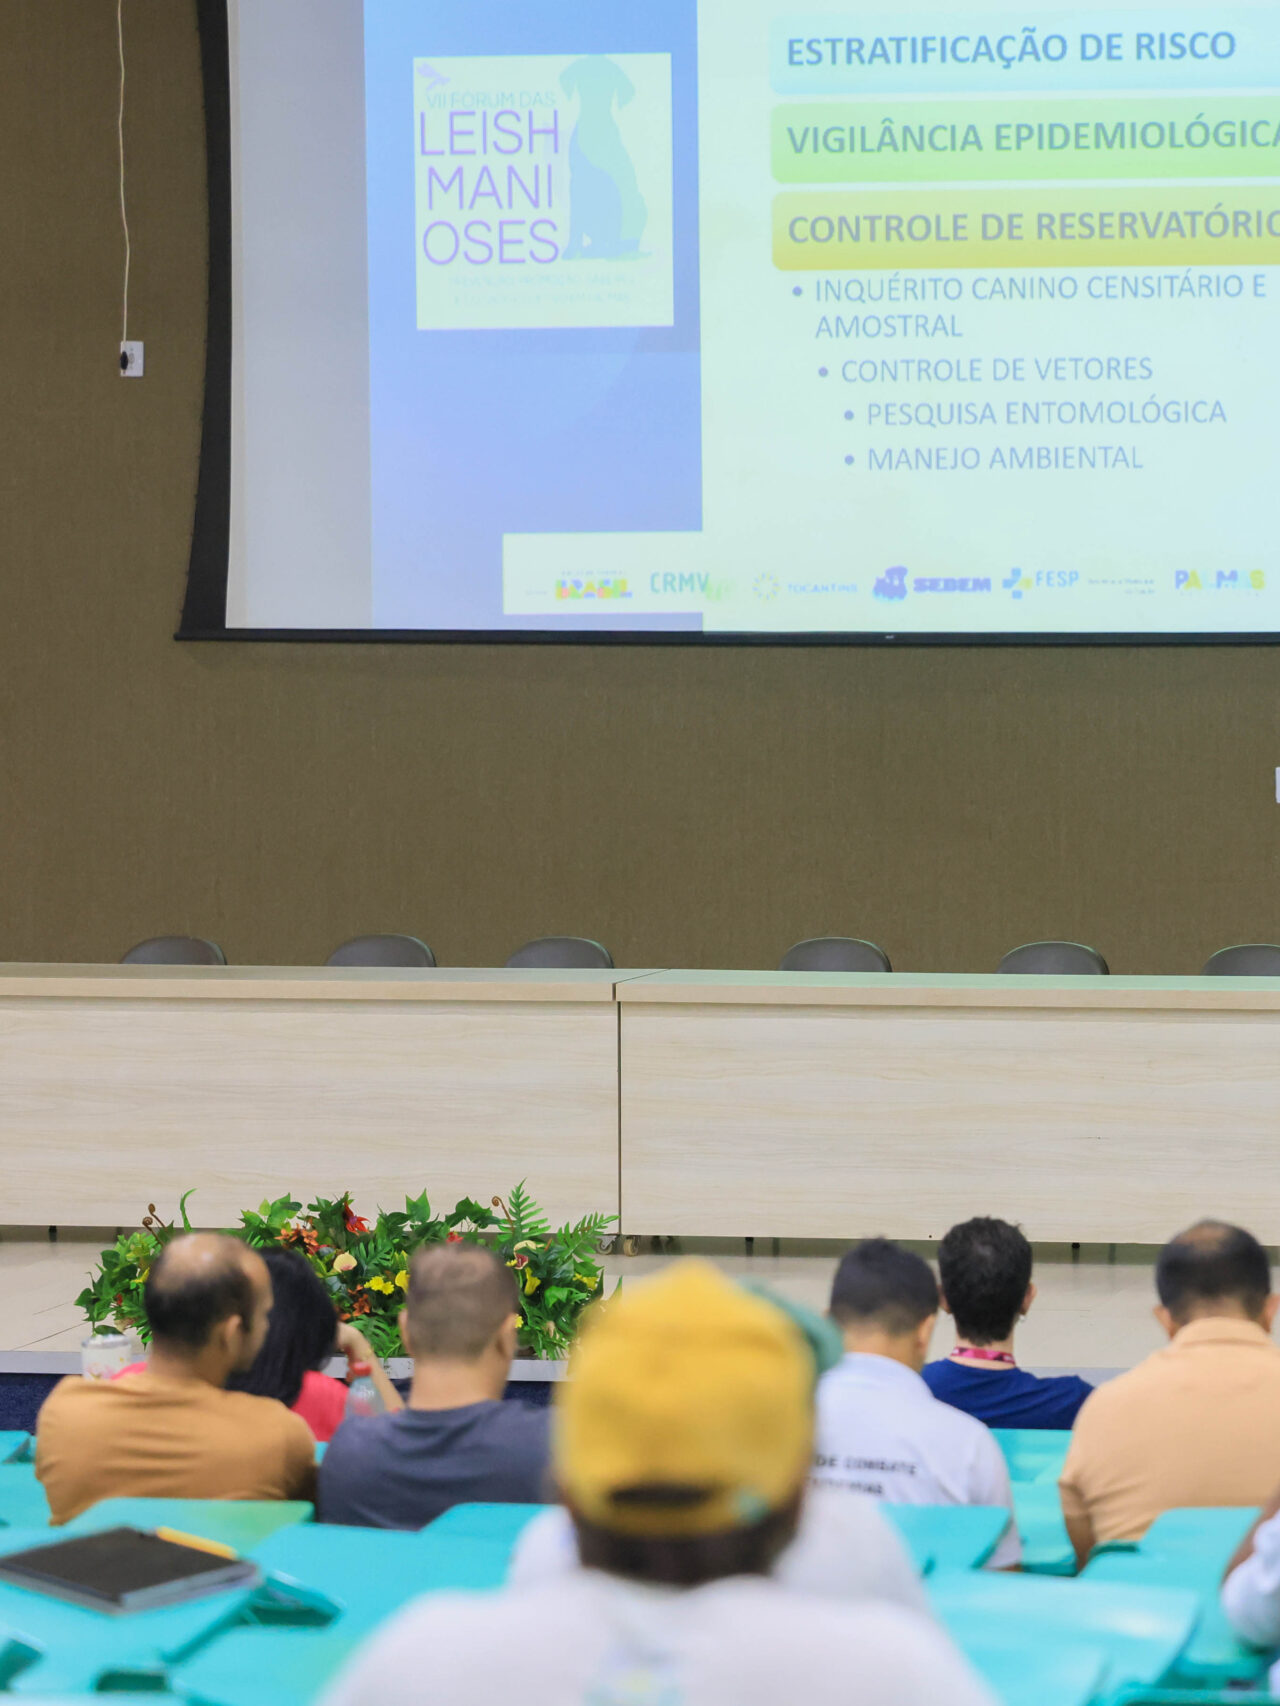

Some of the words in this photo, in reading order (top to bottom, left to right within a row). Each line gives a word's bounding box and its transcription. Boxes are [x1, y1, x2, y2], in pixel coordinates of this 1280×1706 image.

[787, 27, 1068, 69] ESTRATIFICAÇÃO
[1080, 33, 1124, 62] DE
[1135, 31, 1236, 60] RISCO
[520, 91, 556, 107] DAS
[420, 109, 559, 156] LEISH
[787, 118, 983, 154] VIGILÂNCIA
[428, 164, 553, 210] MANI
[423, 219, 560, 265] OSES
[788, 214, 969, 244] CONTROLE
[981, 213, 1024, 242] DE
[816, 272, 964, 304] INQUÉRITO
[972, 275, 1078, 301] CANINO
[1087, 268, 1244, 300] CENSITÁRIO
[1253, 275, 1266, 298] E
[815, 314, 963, 339] AMOSTRAL
[841, 359, 982, 383] CONTROLE
[993, 358, 1025, 382] DE
[1035, 357, 1153, 381] VETORES
[867, 402, 997, 429] PESQUISA
[1006, 395, 1227, 425] ENTOMOLÓGICA
[868, 446, 981, 471] MANEJO
[989, 446, 1144, 470] AMBIENTAL
[650, 571, 709, 594] CRMV
[1035, 570, 1079, 587] FESP
[1175, 569, 1266, 590] PALMAS
